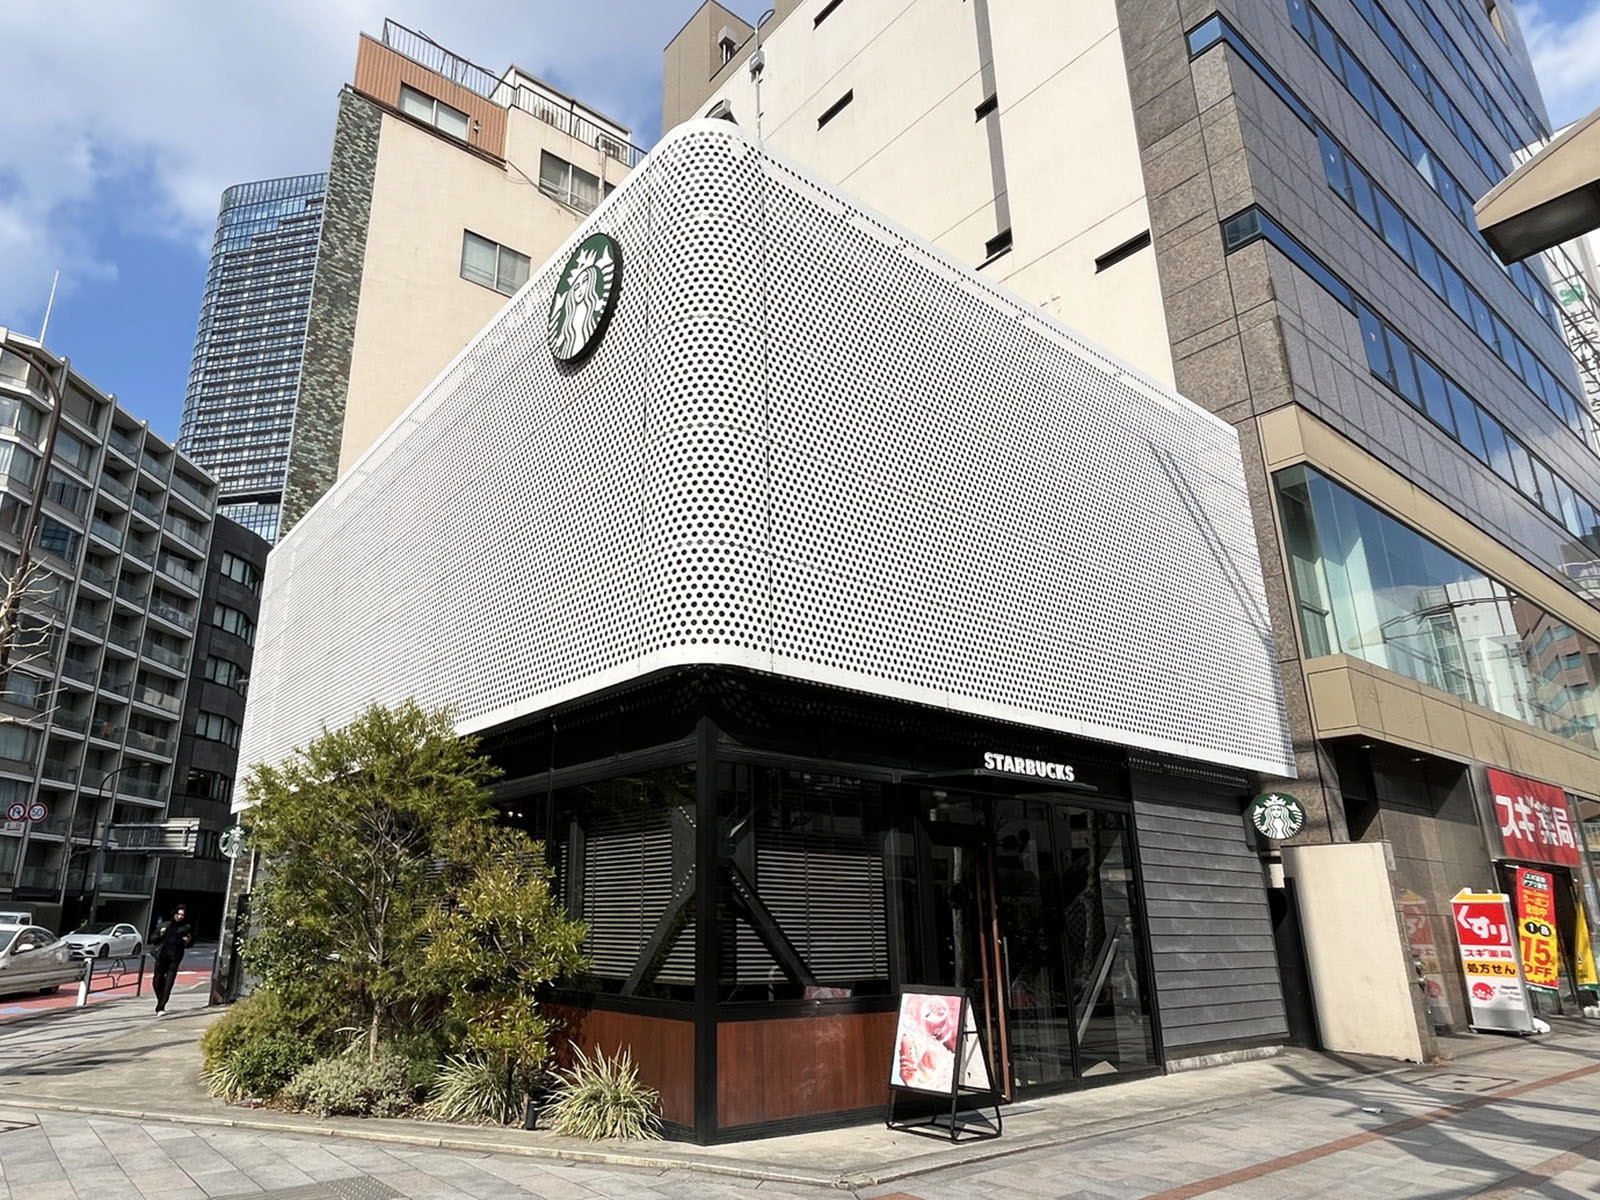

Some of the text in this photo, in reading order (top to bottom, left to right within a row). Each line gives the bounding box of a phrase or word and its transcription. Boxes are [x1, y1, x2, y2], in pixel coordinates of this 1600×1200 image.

[984, 752, 1075, 781] STARBUCKS
[32, 807, 43, 817] 50
[1495, 795, 1575, 849] スギ薬局
[1457, 905, 1509, 944] くすり
[1464, 948, 1512, 958] スギ薬局
[1467, 963, 1516, 975] 処方せん
[1523, 963, 1552, 977] OFF
